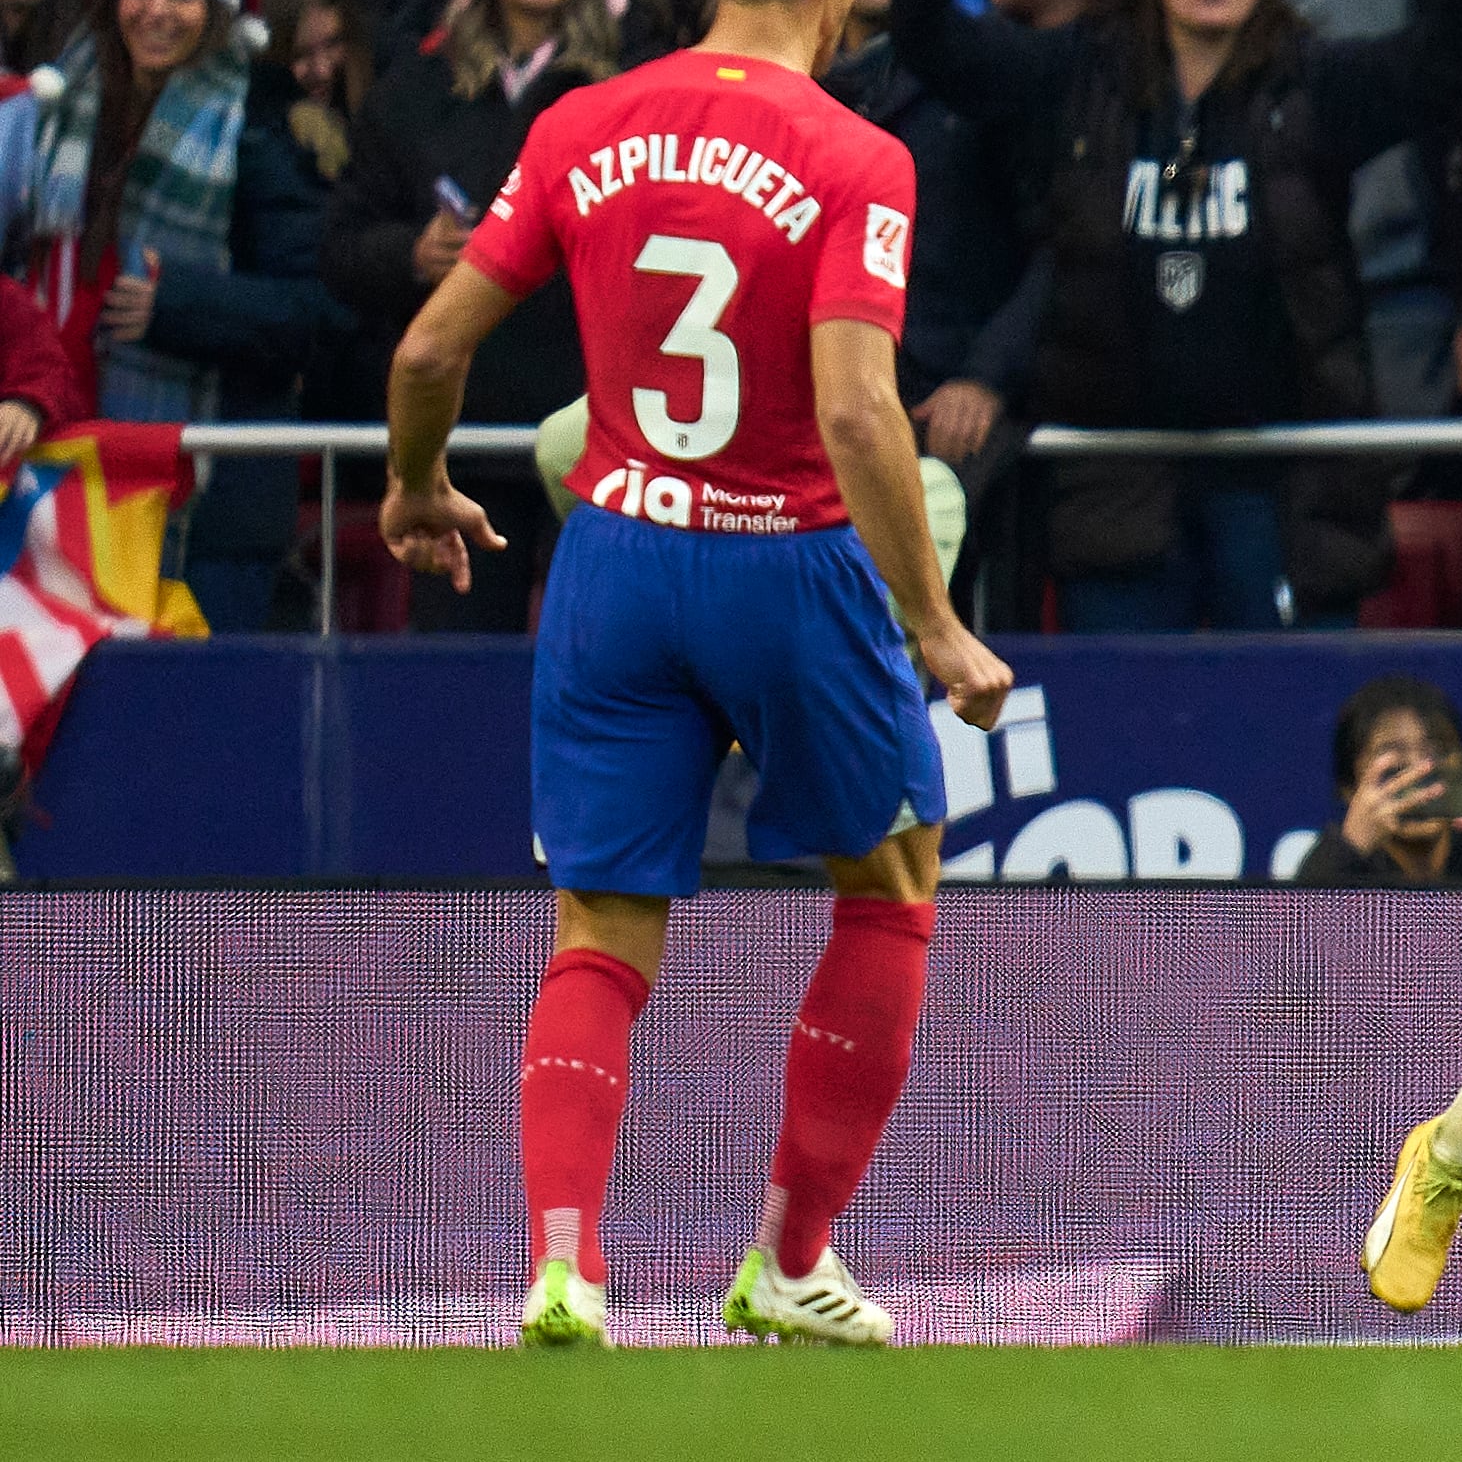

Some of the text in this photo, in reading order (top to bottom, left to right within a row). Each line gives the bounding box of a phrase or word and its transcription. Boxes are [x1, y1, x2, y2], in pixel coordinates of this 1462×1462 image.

[567, 133, 822, 246] AZPILICUETA
[632, 233, 740, 463] 3
[591, 458, 692, 529] ria
[700, 504, 799, 535] Transfer
[701, 482, 786, 511] Money
